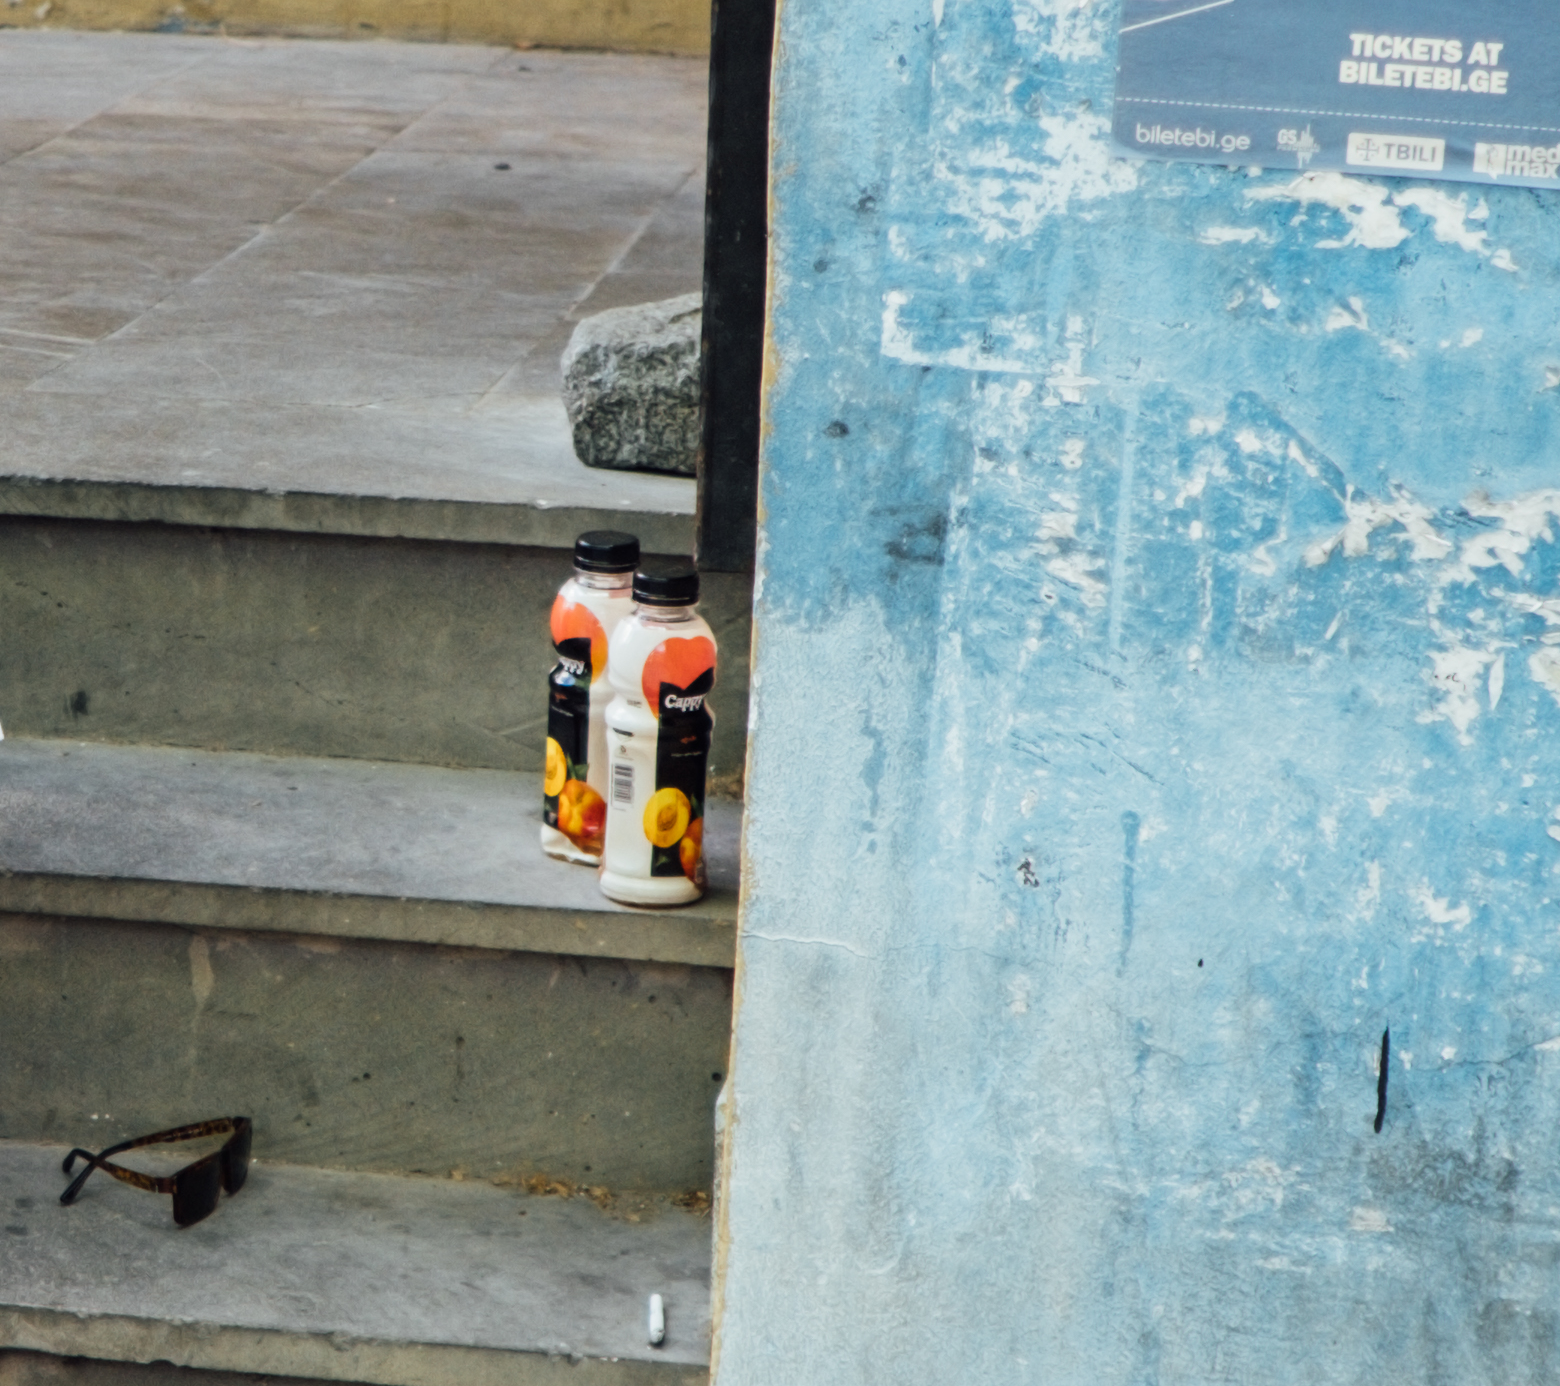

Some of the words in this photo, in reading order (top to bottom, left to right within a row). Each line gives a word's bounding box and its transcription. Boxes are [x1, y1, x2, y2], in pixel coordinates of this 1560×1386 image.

[1350, 33, 1463, 63] TICKETS
[1467, 42, 1503, 66] AT
[1339, 60, 1509, 95] BILETEBI.GE
[1135, 123, 1251, 152] biletebi.ge
[1277, 129, 1297, 144] GS
[1383, 143, 1436, 163] TBILI
[1506, 160, 1559, 180] max
[664, 694, 707, 712] Cappy
